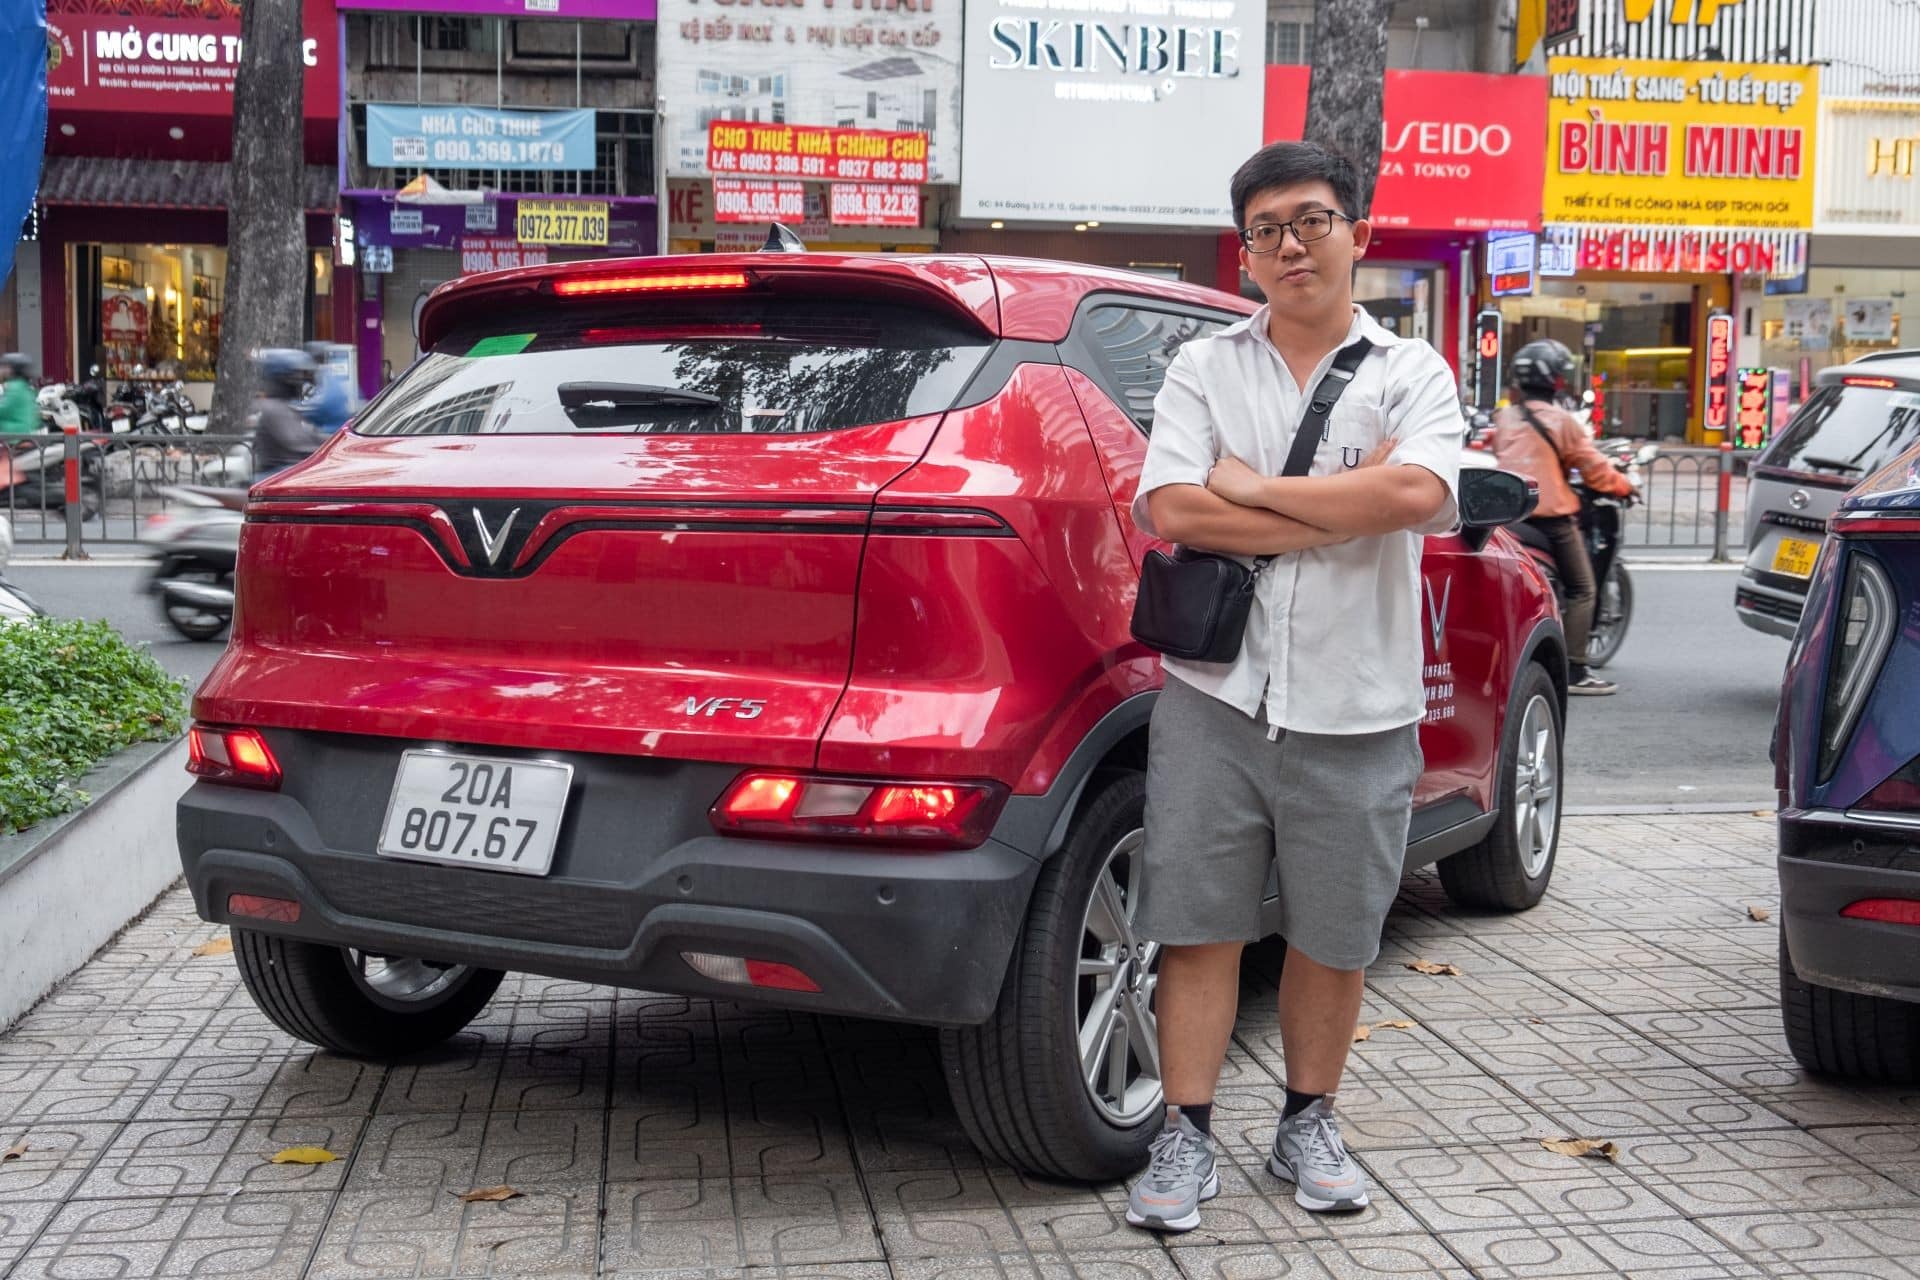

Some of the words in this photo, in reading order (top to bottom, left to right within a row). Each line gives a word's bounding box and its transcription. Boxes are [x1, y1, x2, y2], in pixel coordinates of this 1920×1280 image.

[97, 25, 143, 60] MỞ
[147, 33, 217, 62] CUNG
[989, 16, 1241, 78] SKINBEE
[1635, 77, 1686, 103] SANG
[1727, 69, 1764, 105] BẾP
[462, 116, 495, 136] CHO
[713, 126, 747, 150] CHO
[752, 127, 793, 152] THUÊ
[797, 130, 832, 155] NHÀ
[836, 131, 888, 158] CHÍNH
[892, 133, 925, 160] CHỦ
[1560, 108, 1671, 176] BÌNH
[1684, 123, 1804, 180] MINH
[1414, 163, 1471, 179] TOKYO
[519, 214, 605, 241] 0972.377.039
[1342, 446, 1362, 468] U
[440, 762, 513, 809] 20A
[400, 807, 538, 862] 807.67
